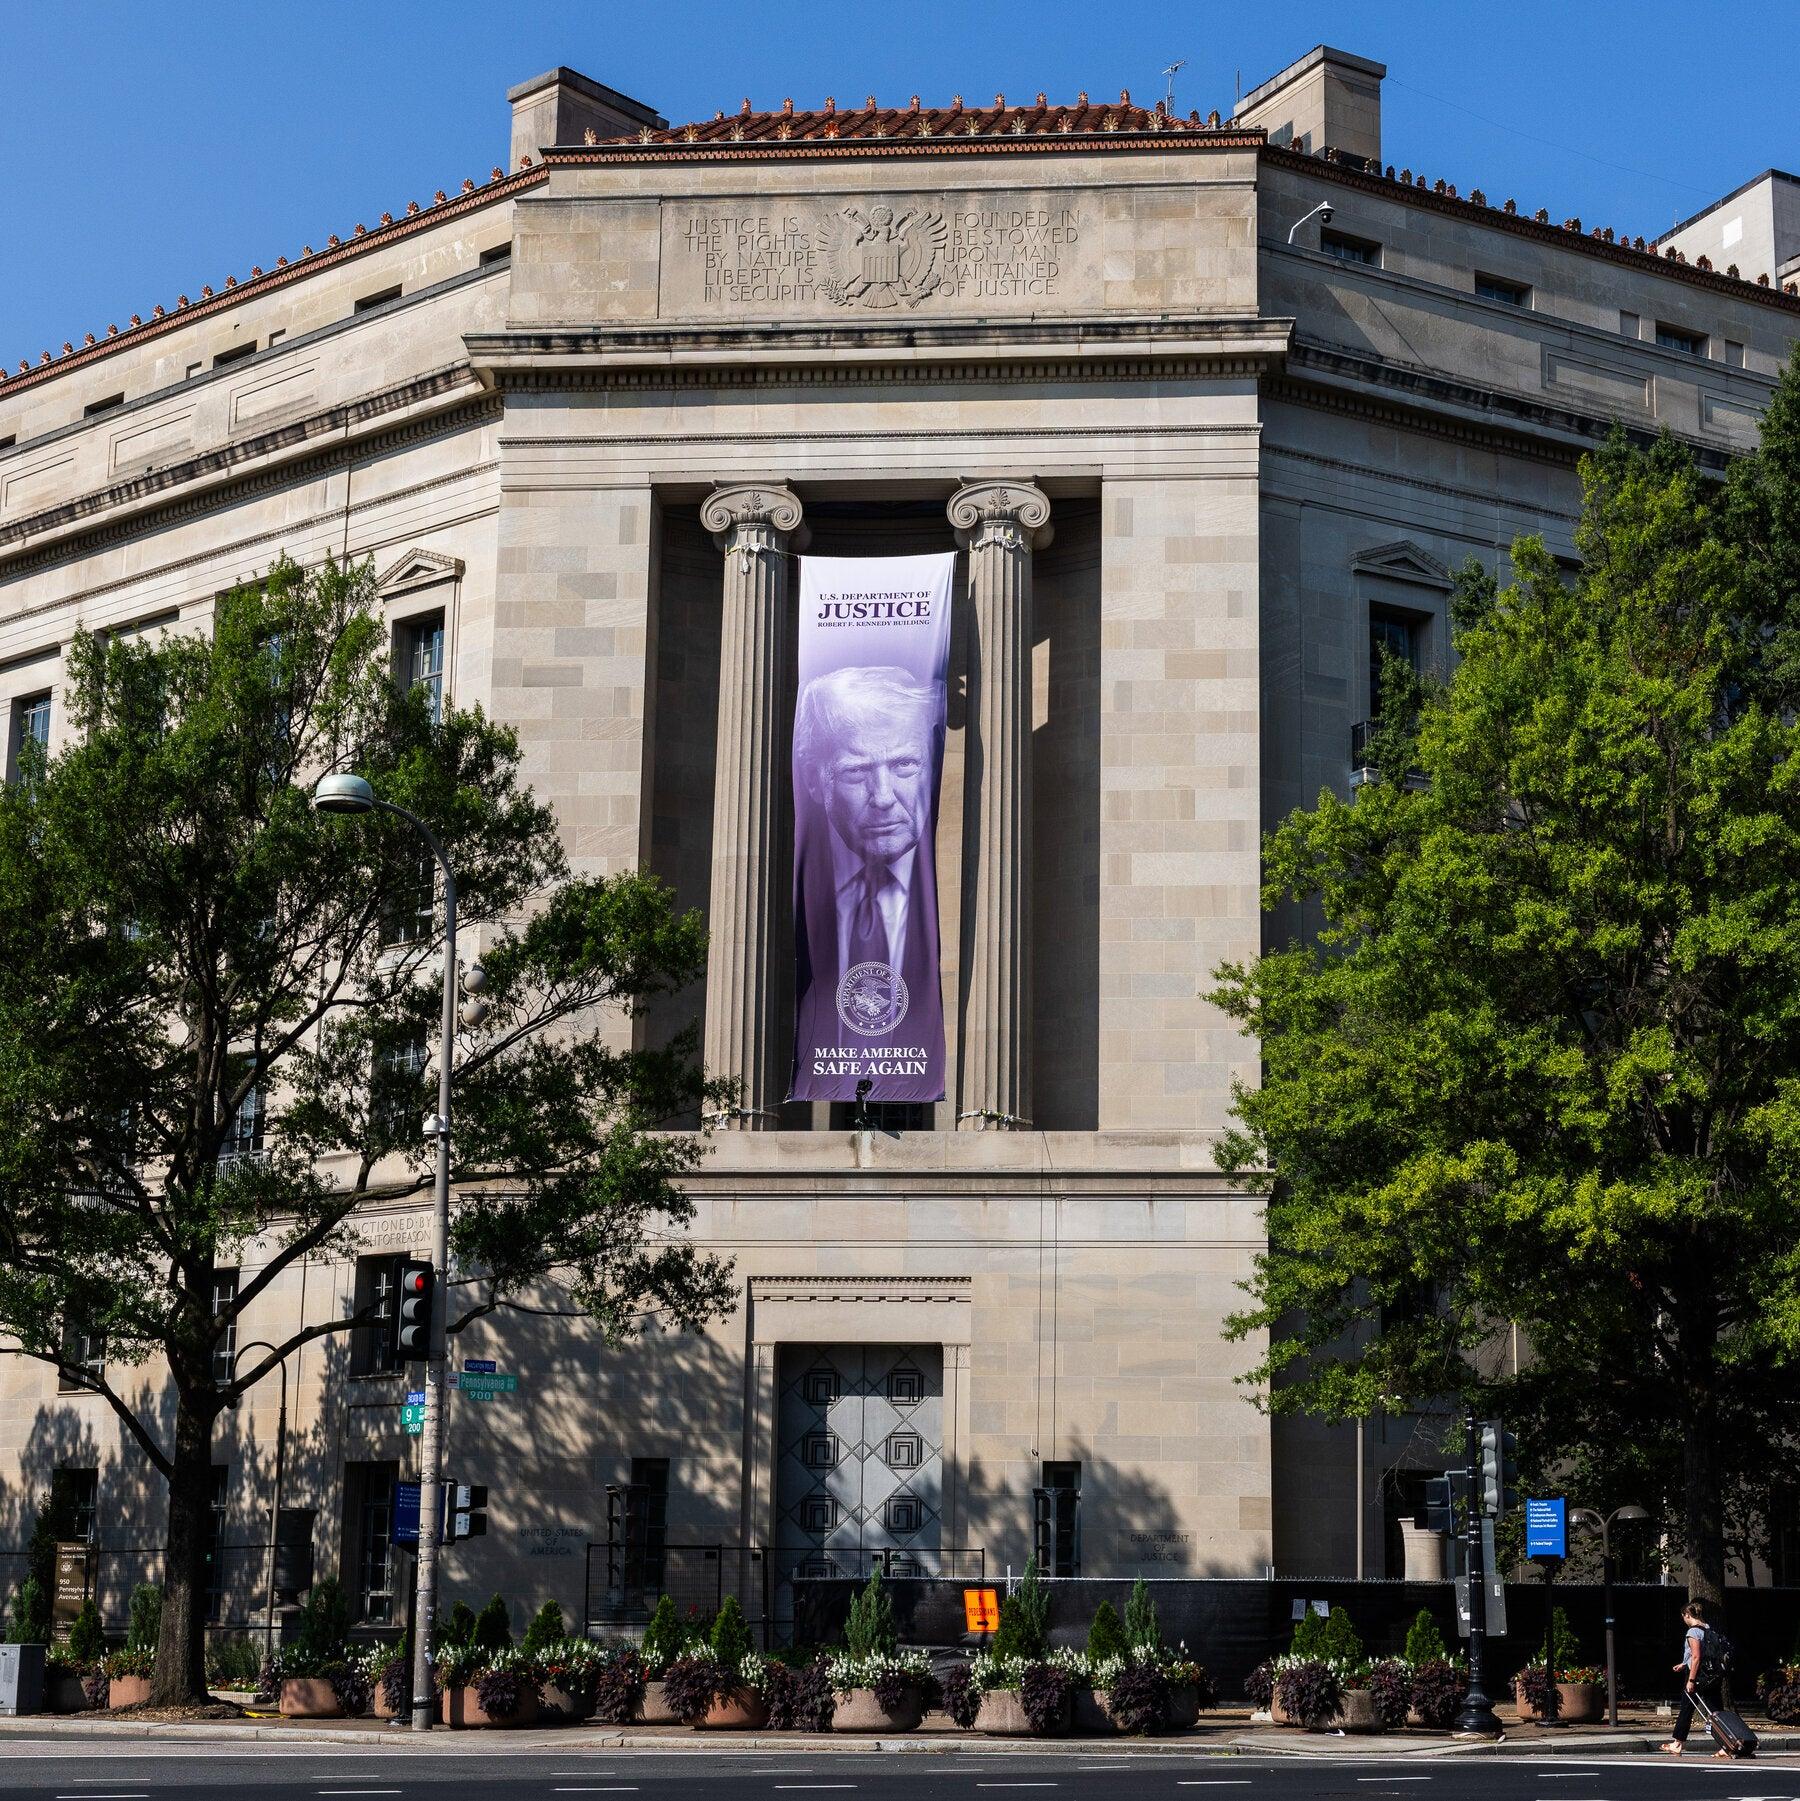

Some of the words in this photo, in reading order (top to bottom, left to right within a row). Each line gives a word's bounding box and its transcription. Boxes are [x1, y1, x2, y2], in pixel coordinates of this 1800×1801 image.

[683, 218, 769, 235] JUSTICE
[783, 216, 799, 233] IS
[955, 211, 1049, 228] FOUNDED
[1062, 210, 1080, 227] IN
[684, 236, 722, 252] THE
[954, 228, 1078, 246] BESTOWED
[706, 252, 728, 268] BY
[943, 246, 999, 262] UPON
[1012, 246, 1060, 262] MAN.
[798, 268, 813, 283] IS
[943, 262, 1058, 279] MAINTAINED
[704, 286, 722, 302] IN
[939, 281, 966, 297] OF
[974, 279, 1060, 297] JUSTICE.
[841, 592, 915, 600] DEPARTMENT
[818, 601, 930, 619] JUSTICE
[842, 968, 874, 1008] DEPARTMENT
[814, 1048, 857, 1058] MAKE
[860, 1047, 928, 1058] AMERICA
[813, 1062, 861, 1075] SAFE
[864, 1062, 928, 1075] AGAIN
[420, 1215, 432, 1228] BY
[461, 1376, 505, 1390] Pennsylvania
[470, 1392, 491, 1400] 900
[406, 1408, 412, 1422] 9
[408, 1423, 420, 1432] 200
[520, 1528, 552, 1537] UNITED
[556, 1528, 584, 1537] STATES
[1130, 1534, 1189, 1542] DEPARTMENT
[546, 1538, 557, 1546] OF
[530, 1547, 572, 1555] AMERICA
[1142, 1553, 1178, 1561] JUSTICE
[59, 1586, 93, 1594] Pennsylvaia
